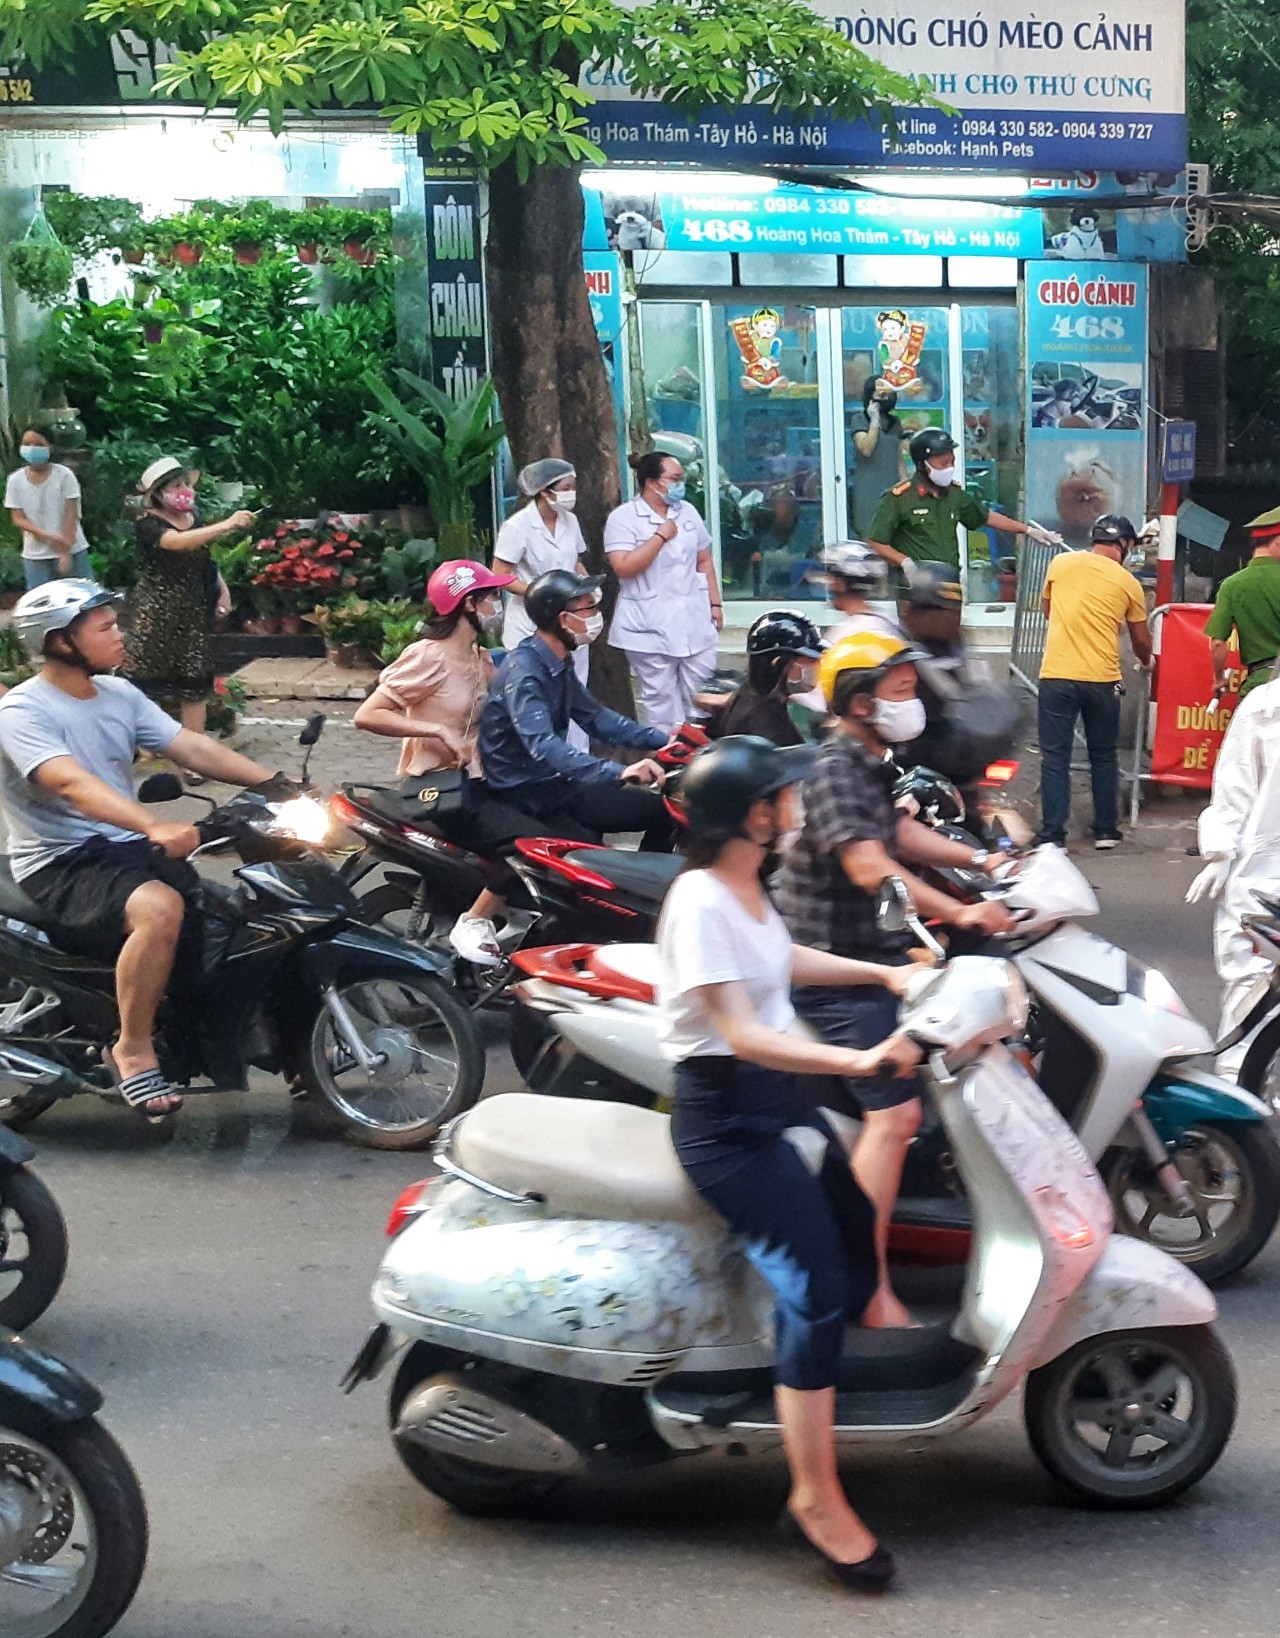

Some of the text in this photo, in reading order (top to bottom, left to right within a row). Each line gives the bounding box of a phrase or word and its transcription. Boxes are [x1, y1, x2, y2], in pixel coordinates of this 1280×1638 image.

[927, 11, 989, 48] CHÓ
[999, 13, 1063, 50] MÈO
[1073, 13, 1152, 52] CẢNH
[965, 73, 1018, 97] CHO
[1024, 72, 1076, 97] THÚ
[606, 122, 639, 142] Hoa
[643, 122, 690, 143] Thám
[734, 121, 758, 144] Hồ
[773, 124, 795, 146] Hà
[800, 126, 827, 150] Nội
[911, 119, 937, 135] line
[962, 120, 996, 136] 0984
[1000, 121, 1024, 138] 330
[1062, 121, 1096, 139] 0904
[1100, 122, 1125, 140] 339
[1128, 123, 1153, 141] 727
[961, 141, 999, 160] Hạnh
[1002, 141, 1034, 158] Pets
[764, 198, 810, 214] 0984
[816, 199, 850, 215] 330
[681, 218, 753, 243] 468
[757, 225, 807, 246] Hoàng
[811, 227, 841, 243] Hoa
[846, 227, 889, 245] Thám
[903, 226, 931, 250] Tây
[969, 229, 991, 247] Hà
[994, 231, 1021, 249] Nội
[1039, 274, 1136, 306] CHÓ CẢNH
[1049, 314, 1126, 340] 468
